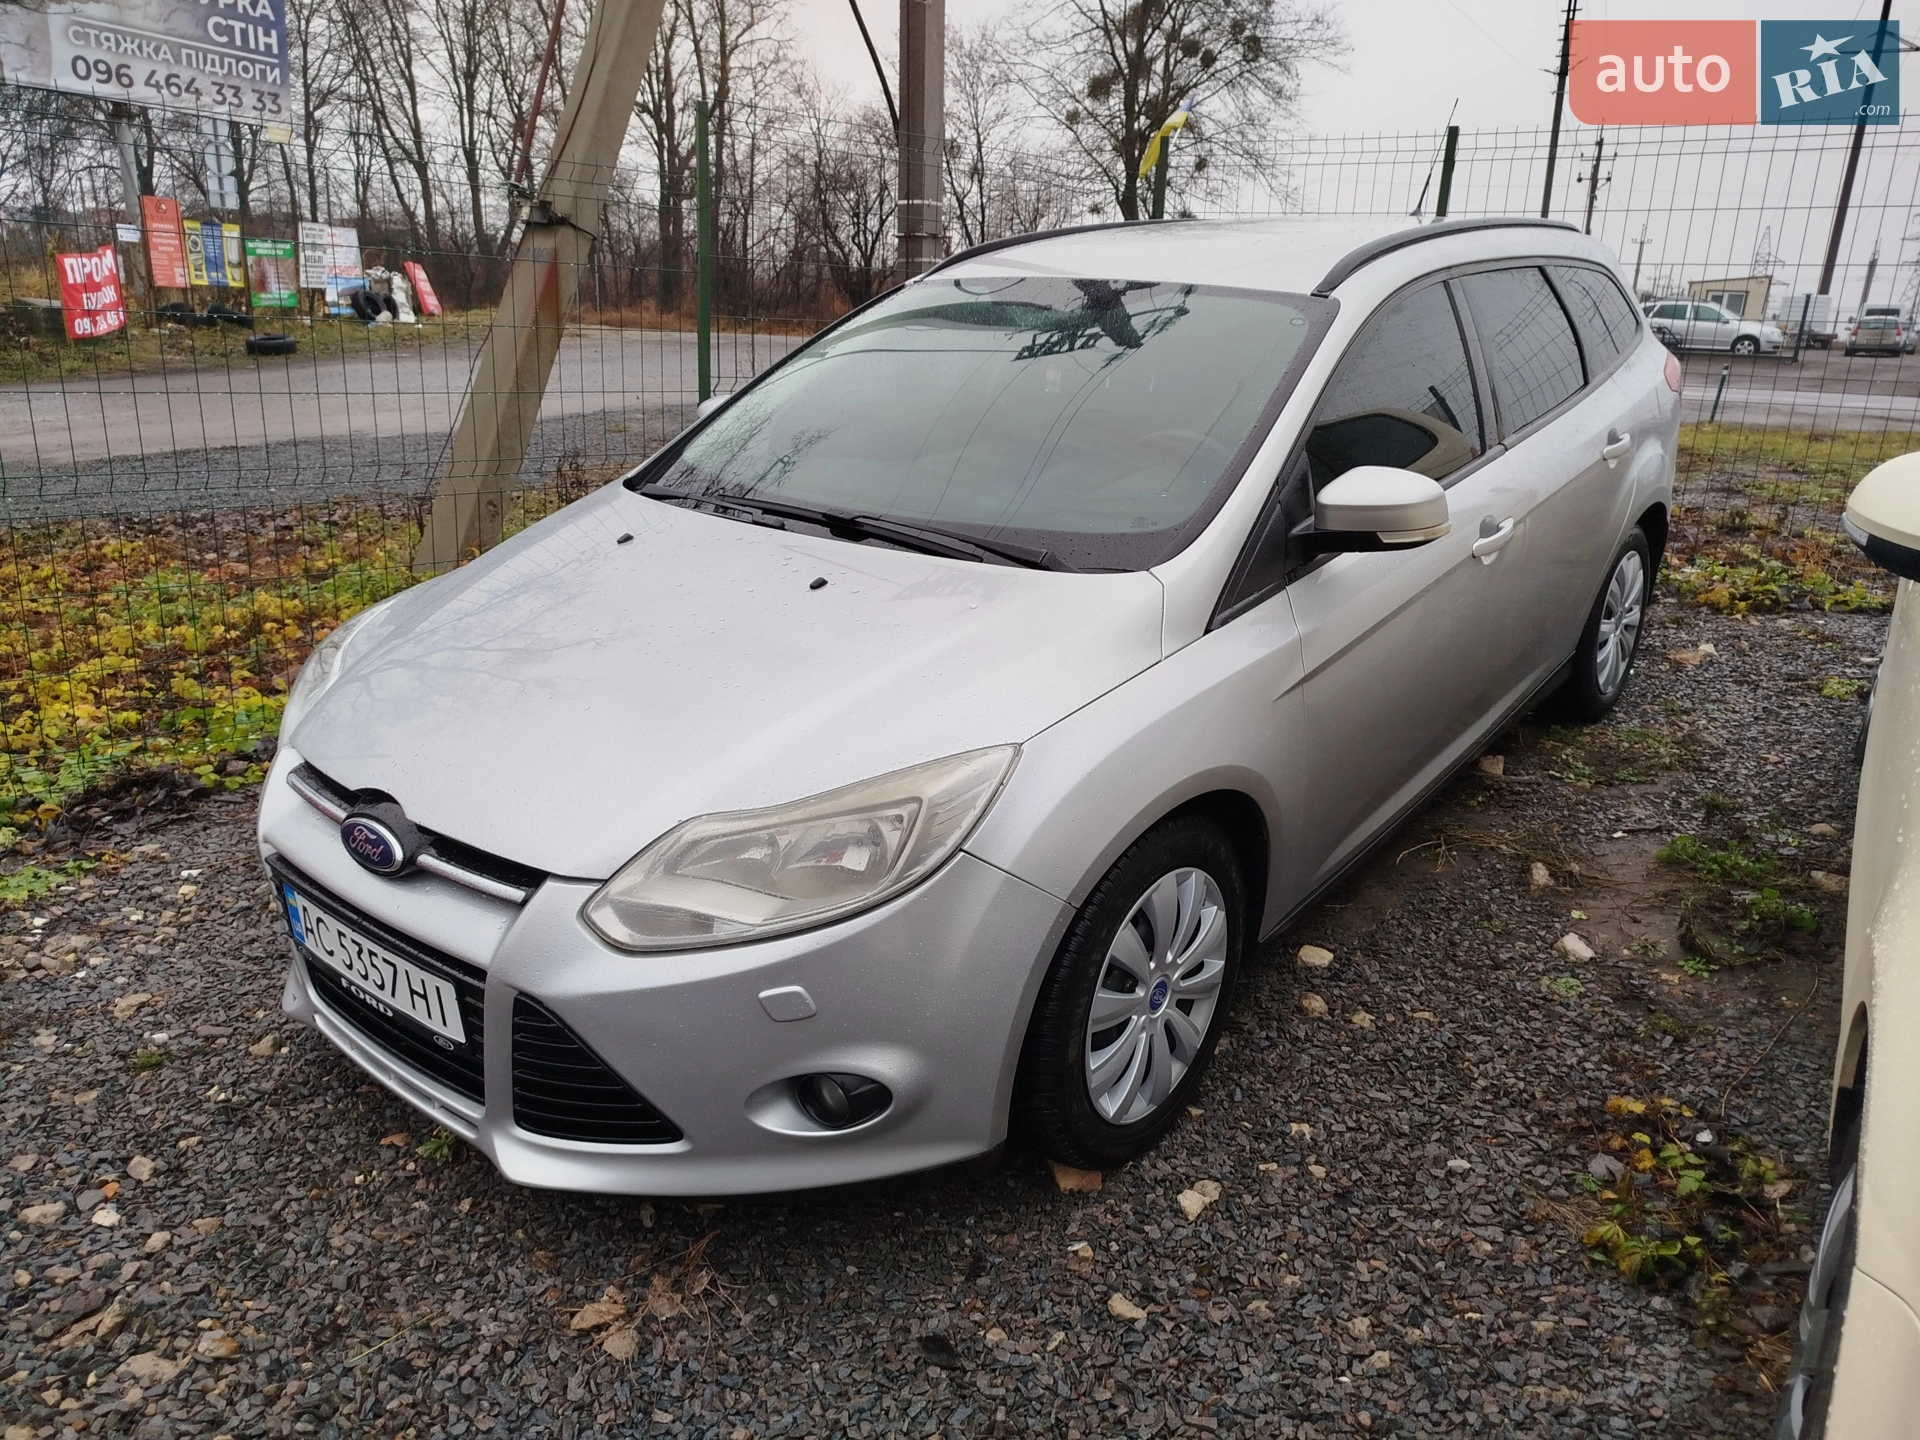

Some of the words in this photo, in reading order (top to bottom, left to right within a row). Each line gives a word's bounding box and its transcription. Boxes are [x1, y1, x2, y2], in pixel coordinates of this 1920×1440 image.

[67, 25, 175, 64] СТЯЖКА
[181, 48, 281, 85] ПІДЛОГИ
[207, 16, 279, 54] СТІН
[71, 55, 134, 89] 096
[144, 69, 203, 99] 464
[211, 81, 243, 108] 33
[251, 89, 282, 114] 33
[349, 825, 385, 862] Ford
[302, 904, 335, 957] AC
[336, 928, 398, 999] 5357
[404, 968, 448, 1028] HI
[340, 977, 393, 1017] FORD
